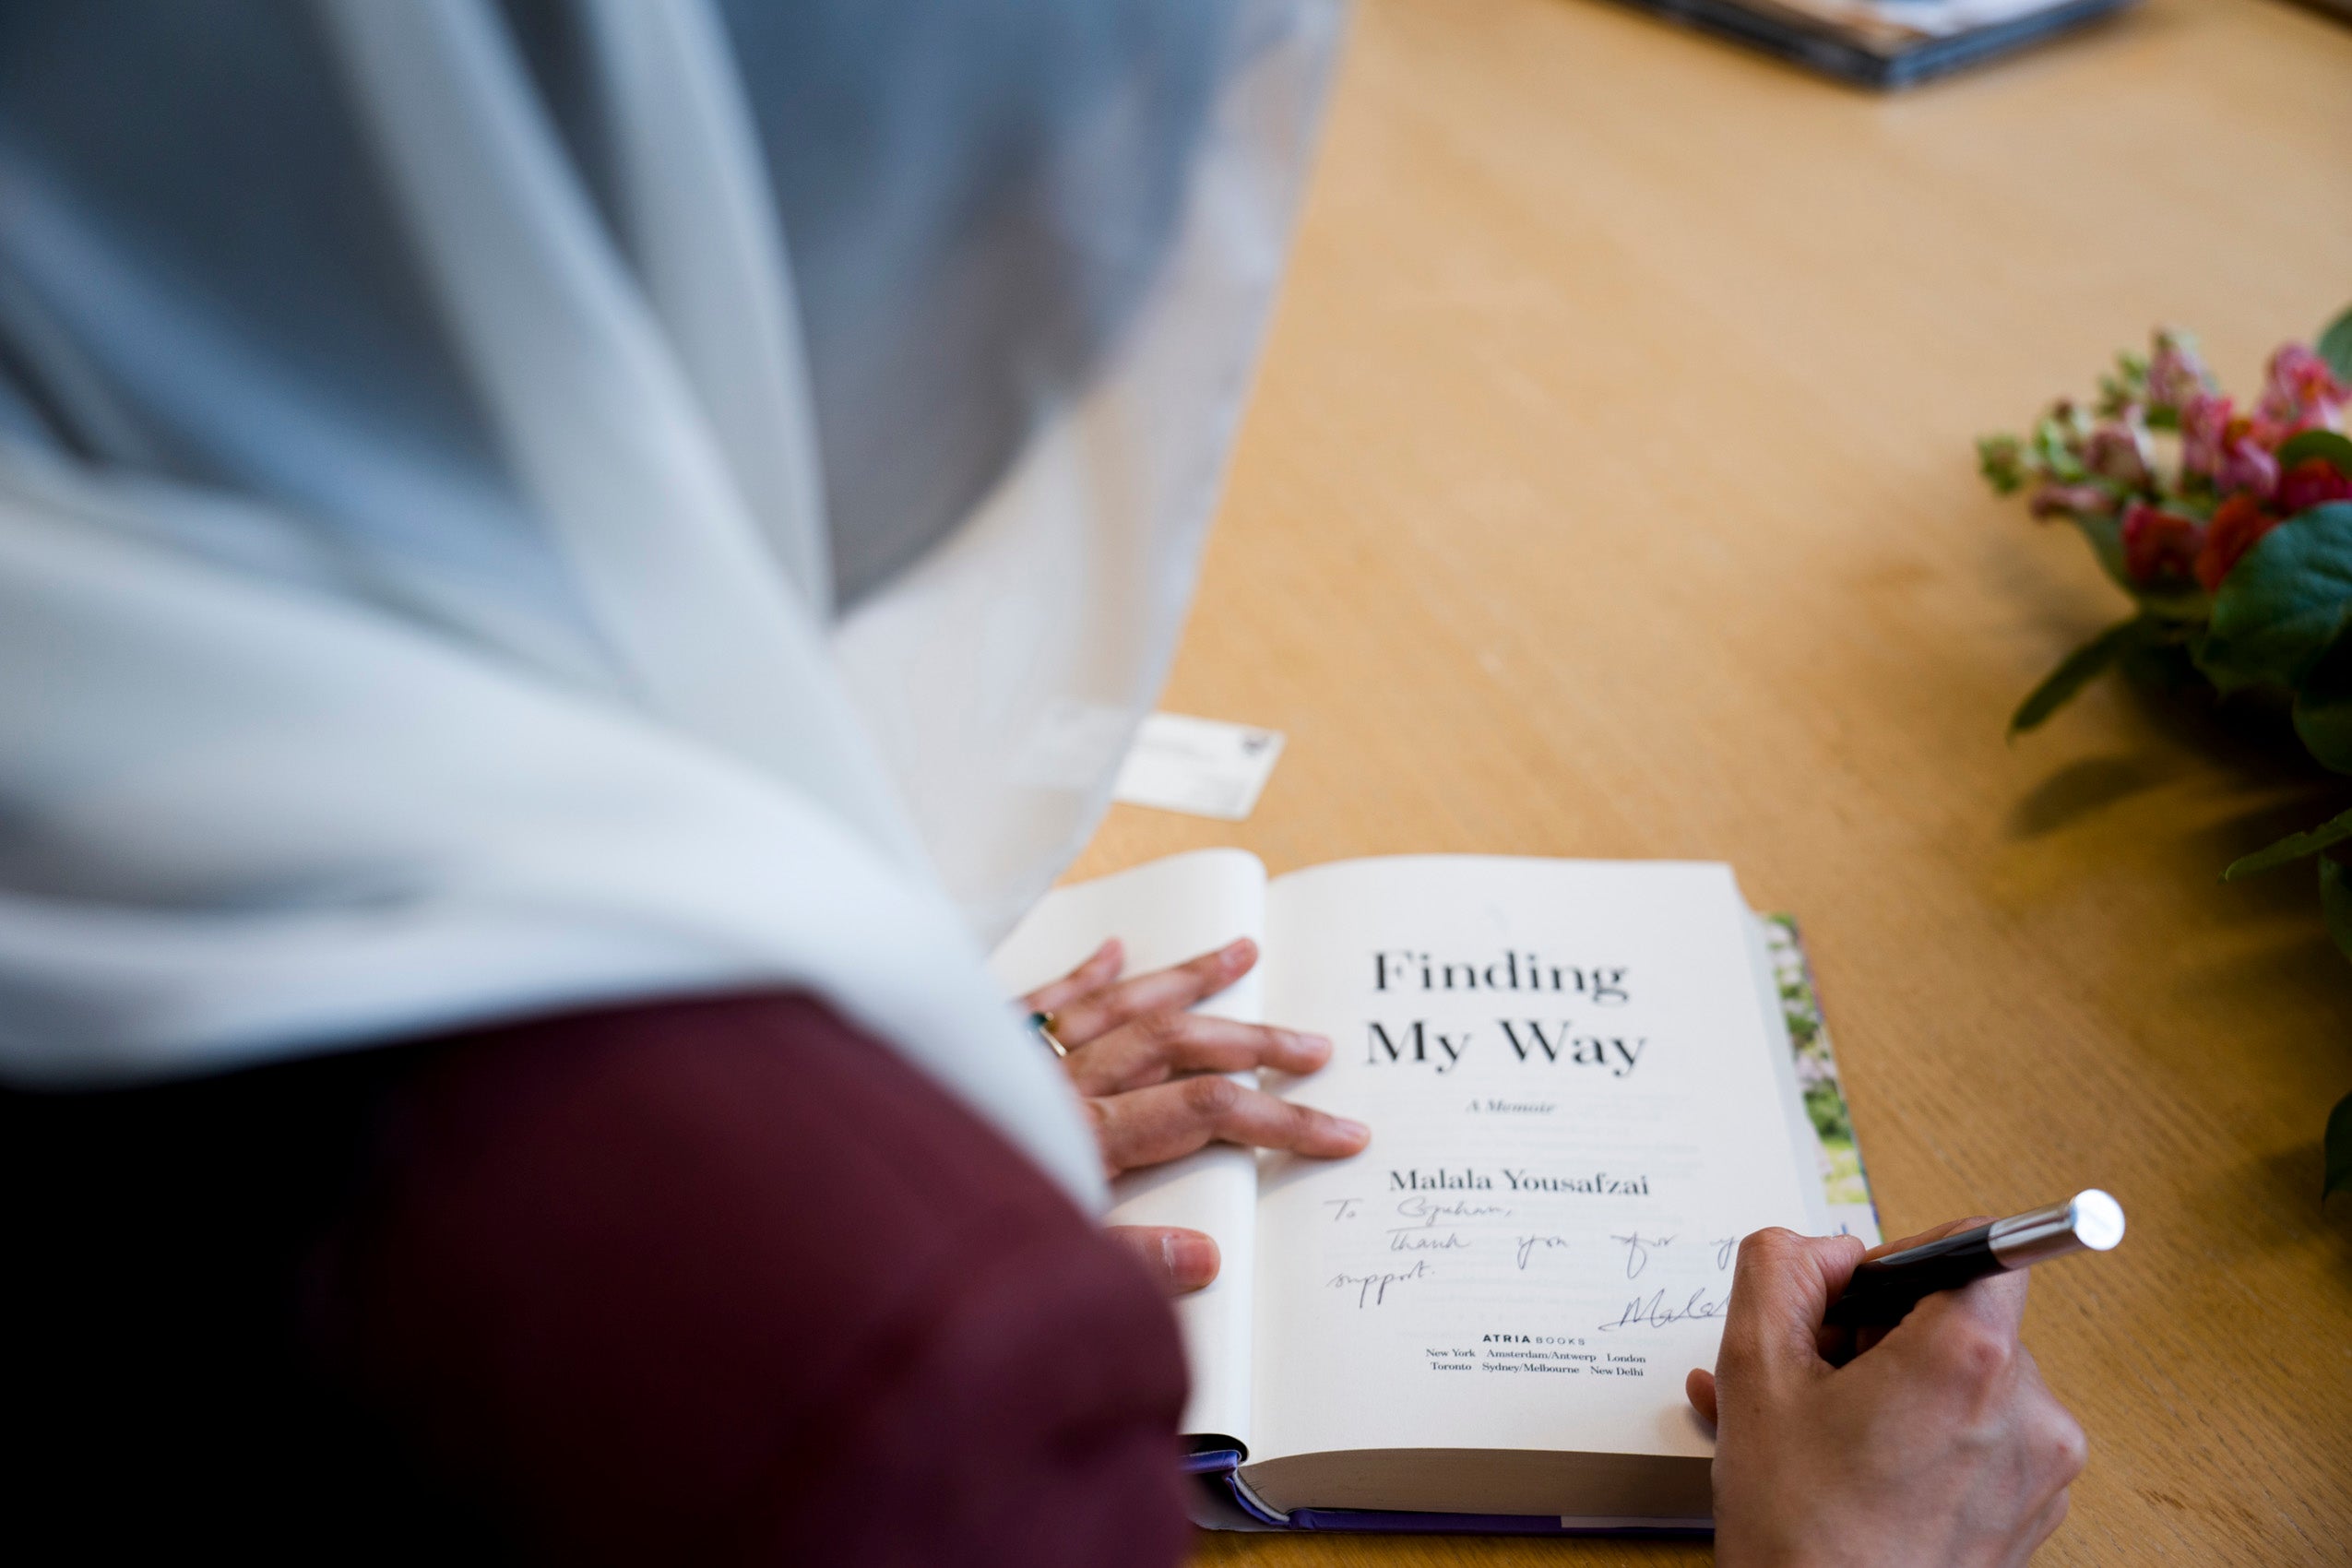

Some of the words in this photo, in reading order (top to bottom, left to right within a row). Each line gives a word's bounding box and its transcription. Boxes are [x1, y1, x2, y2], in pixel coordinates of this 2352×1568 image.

[1372, 948, 1630, 1003] Finding
[1364, 1019, 1472, 1074] My
[1497, 1019, 1647, 1077] Way
[1465, 1099, 1480, 1114] A
[1486, 1099, 1556, 1114] Memoir
[1389, 1170, 1492, 1194] Malala
[1502, 1170, 1650, 1197] Yousafzai
[1385, 1225, 1472, 1252] Thank
[1483, 1334, 1531, 1344] ATRIA
[1536, 1336, 1586, 1347] BOOKS
[1426, 1348, 1448, 1358] New
[1452, 1348, 1476, 1358] York
[1486, 1349, 1597, 1362] Amsterdam/Antwerp
[1607, 1353, 1646, 1363] London
[1431, 1361, 1472, 1371] Toronto
[1482, 1362, 1580, 1374] Sydney/Melbourne
[1590, 1366, 1613, 1375] New
[1616, 1367, 1644, 1377] Delhi
